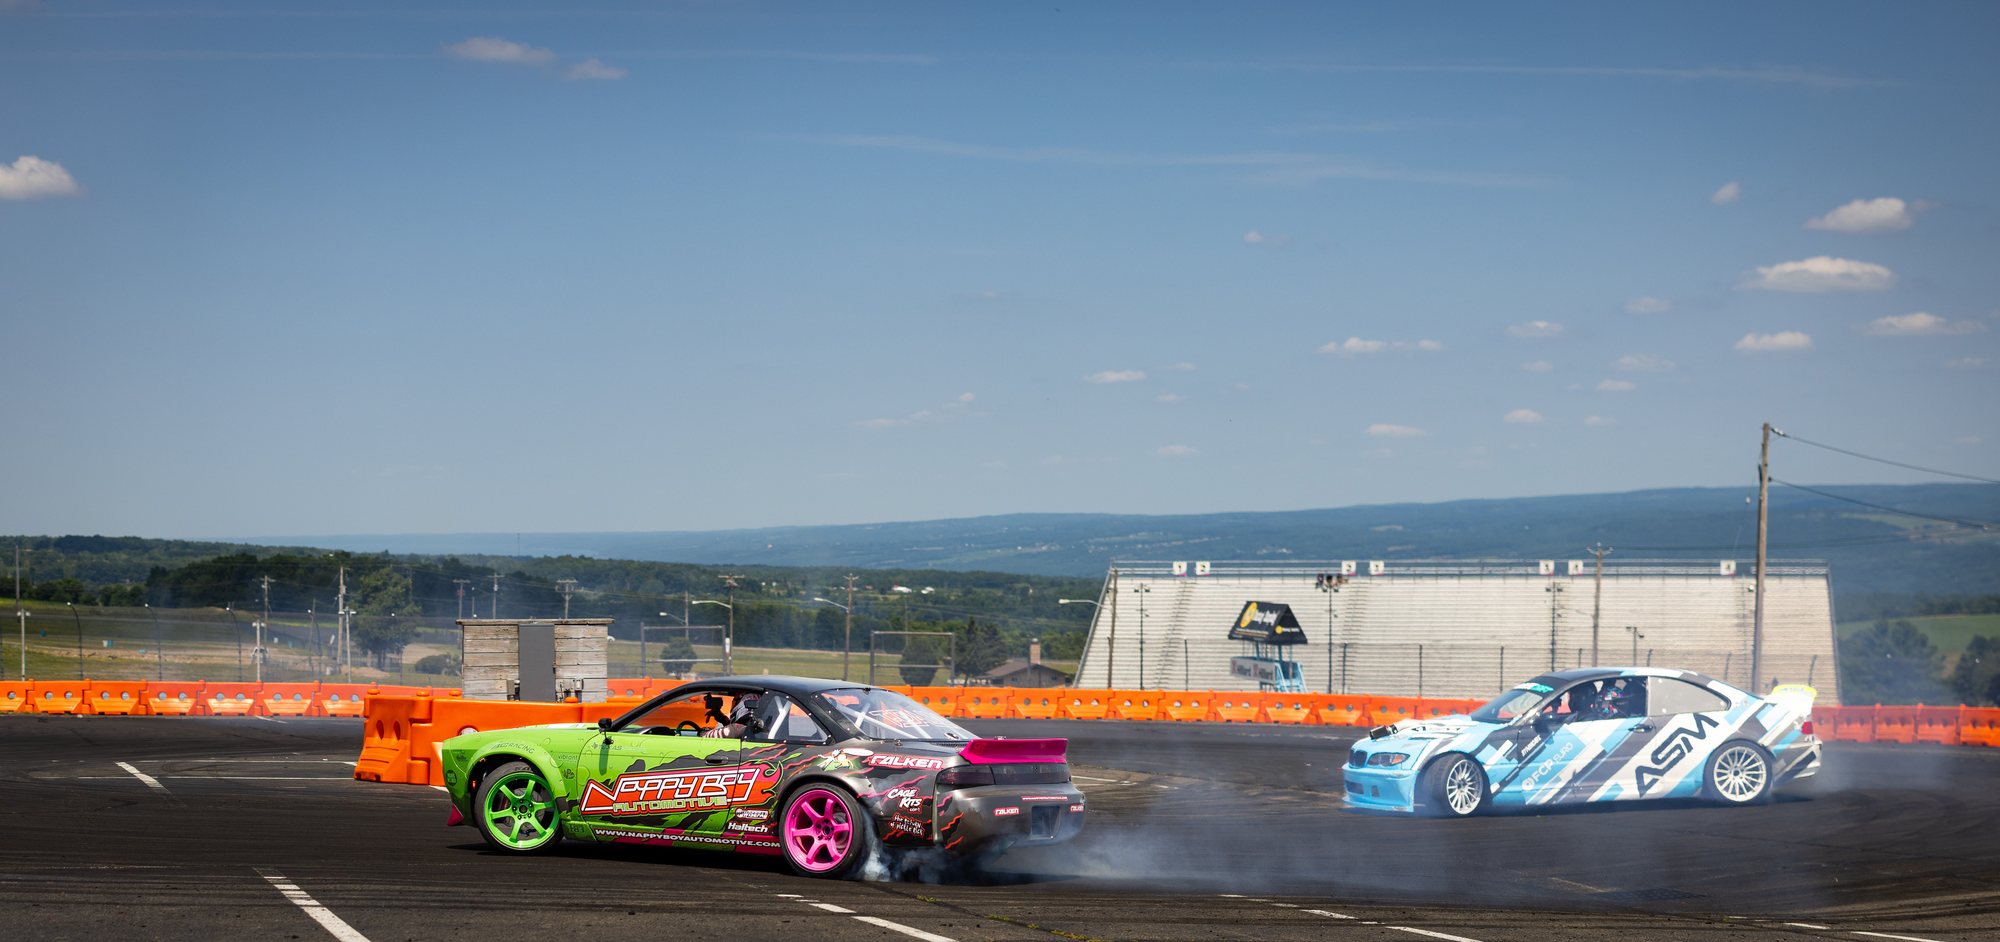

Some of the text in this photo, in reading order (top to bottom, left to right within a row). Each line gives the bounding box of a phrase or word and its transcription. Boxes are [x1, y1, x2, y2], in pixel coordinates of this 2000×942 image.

[870, 755, 943, 769] FALKEN
[1532, 759, 1553, 782] FCP
[1553, 742, 1574, 762] EURO
[1635, 713, 1719, 798] ASM
[887, 789, 917, 798] CAGE
[613, 796, 727, 812] AUTOMOTIVE
[899, 798, 922, 808] KITS
[728, 823, 768, 833] Haltech
[595, 829, 781, 847] WWW.NAPPYBOYAUTOMOTIVE.COM
